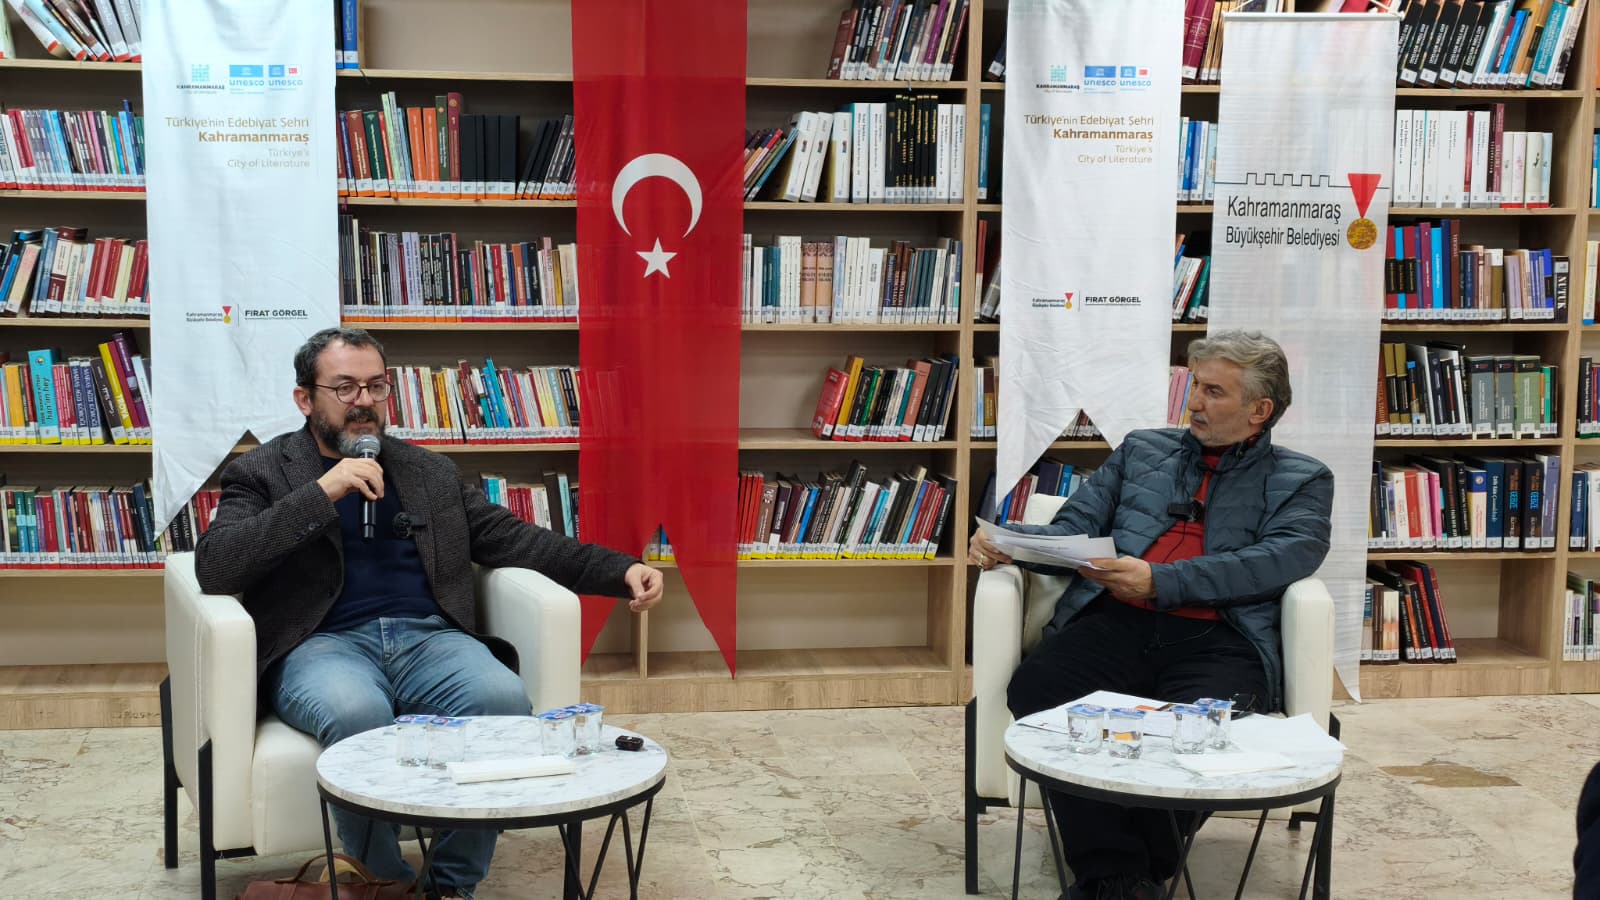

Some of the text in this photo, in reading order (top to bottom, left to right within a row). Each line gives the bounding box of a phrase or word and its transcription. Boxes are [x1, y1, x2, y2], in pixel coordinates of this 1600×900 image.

[228, 116, 277, 129] Edebiyat
[1023, 114, 1077, 126] Türkiye'nin
[1080, 115, 1124, 127] Edebiyat
[199, 131, 309, 145] Kahramanmaraş
[1053, 128, 1153, 142] Kahramanmaraş
[268, 148, 310, 158] Türkiye's
[1115, 144, 1152, 155] Türkiye's
[227, 158, 310, 169] City of Literature
[1078, 154, 1152, 164] City of Literature
[1227, 195, 1342, 224] Kahramanmaraş
[1225, 226, 1340, 250] Büyükşehir Belediyesi
[1109, 295, 1141, 303] GÖRGEL
[1557, 276, 1567, 309] NUTUK
[244, 308, 308, 317] FIRAT GÖRGEL
